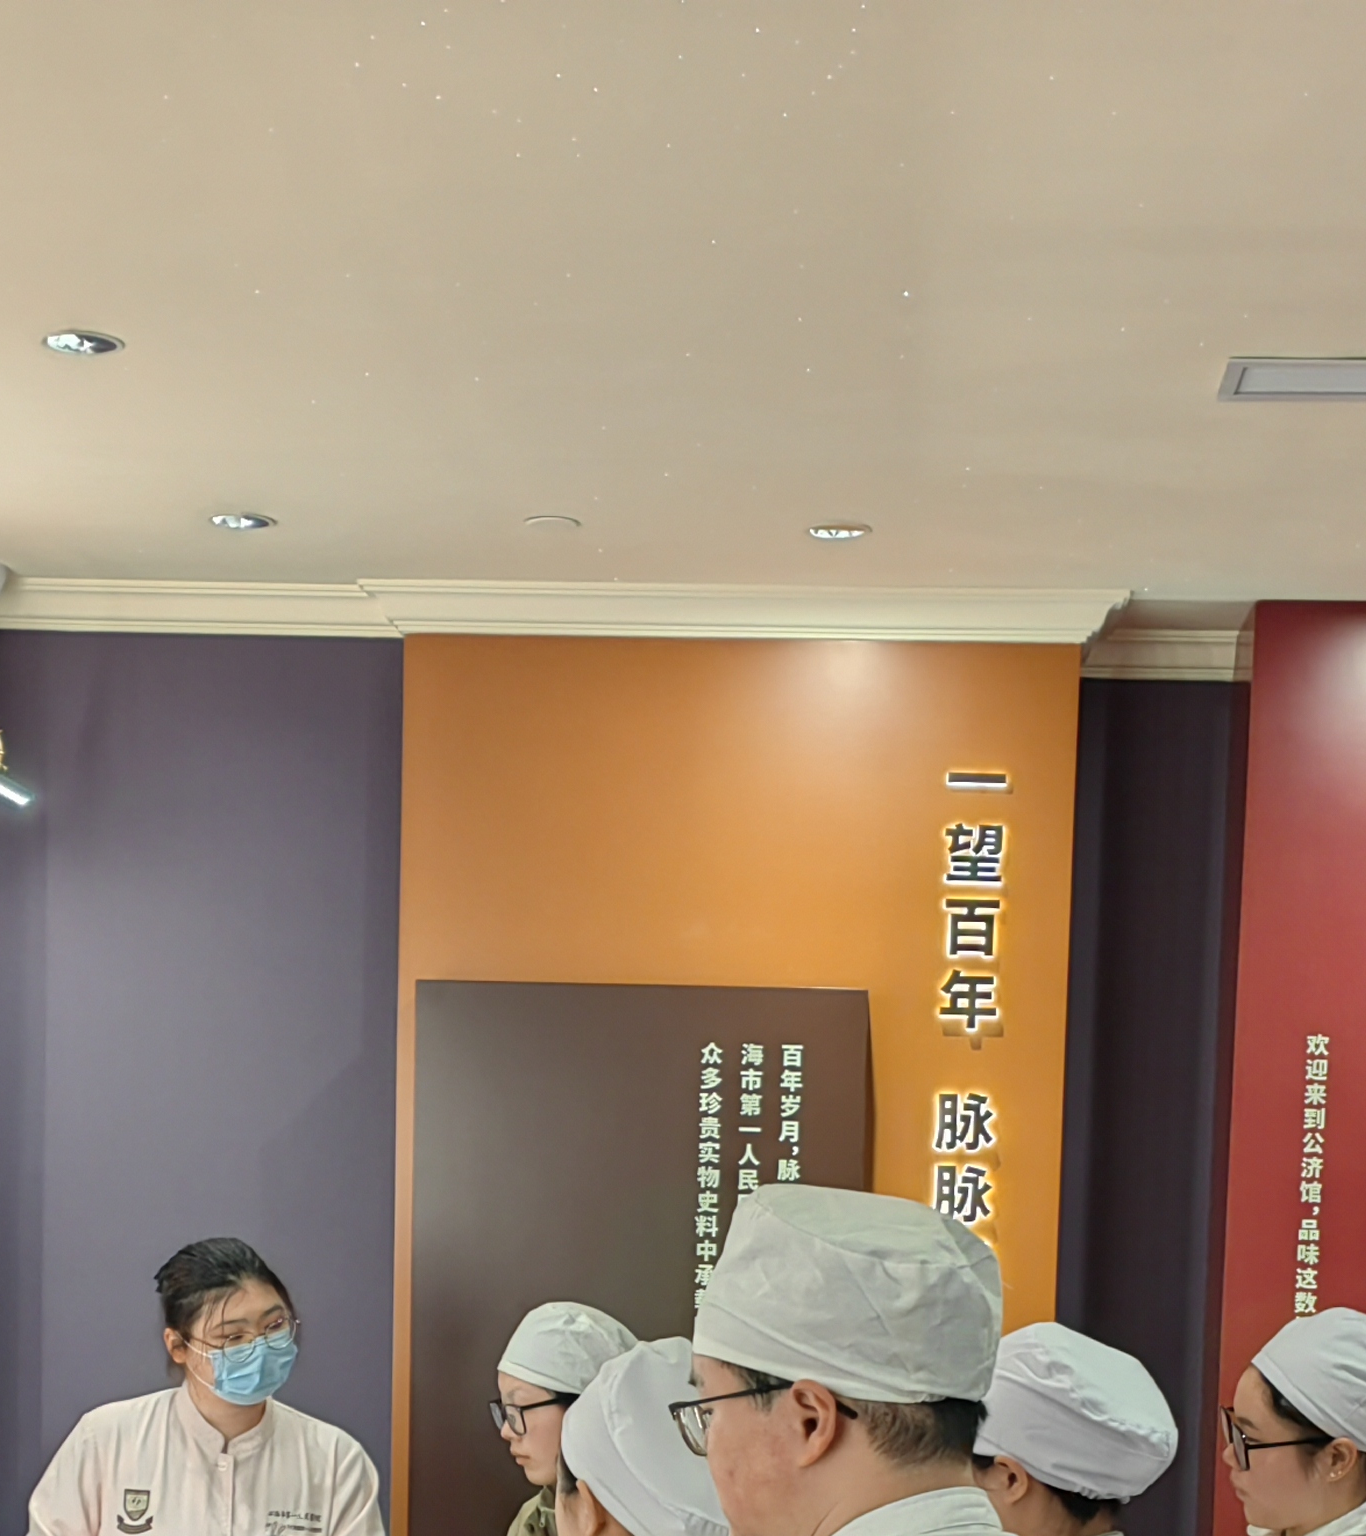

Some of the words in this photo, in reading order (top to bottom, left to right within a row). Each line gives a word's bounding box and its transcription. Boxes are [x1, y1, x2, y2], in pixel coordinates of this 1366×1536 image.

[937, 771, 1008, 1030] 一望百年
[737, 1042, 765, 1202] 海市第一人民
[776, 1043, 804, 1182] 百年岁月，脉
[1294, 1033, 1330, 1320] 欢迎来到公济馆，品味这数
